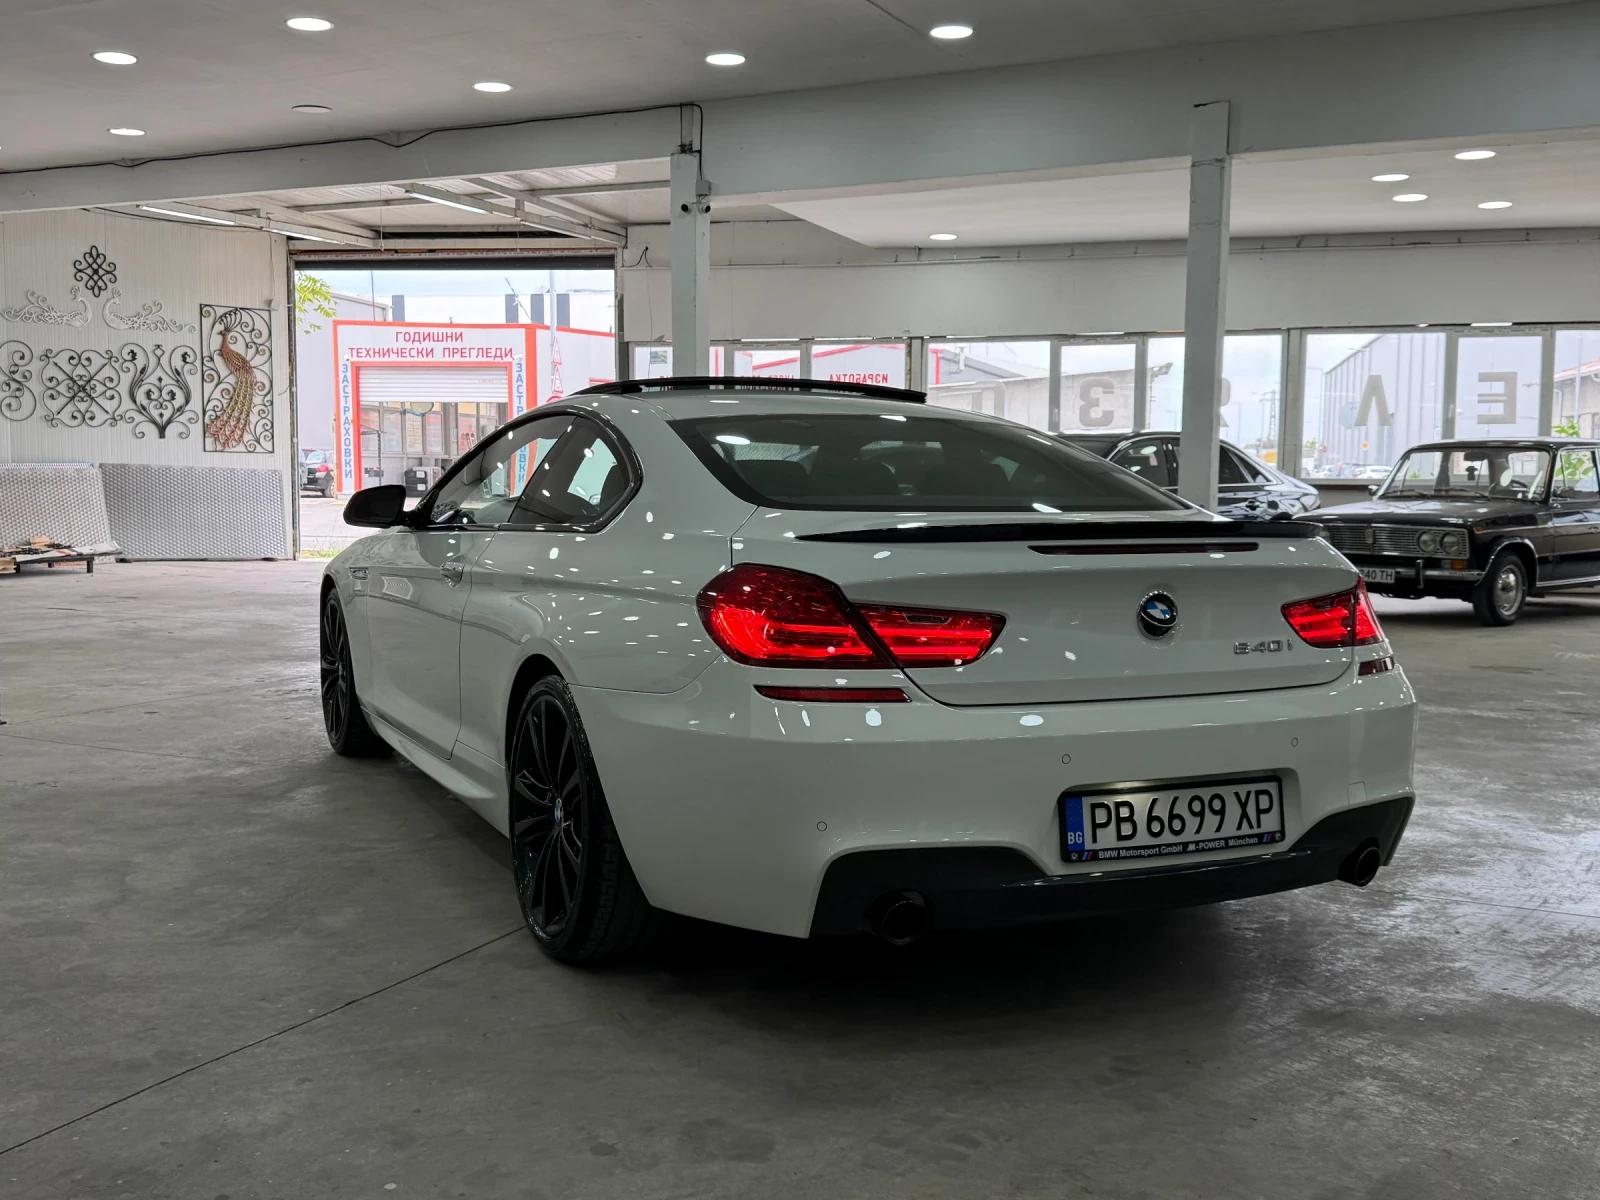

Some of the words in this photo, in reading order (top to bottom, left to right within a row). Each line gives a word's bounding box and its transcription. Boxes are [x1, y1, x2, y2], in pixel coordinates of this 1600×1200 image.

[395, 331, 464, 344] ГОДИШНИ
[348, 347, 434, 359] ТЕХНИЧЕСКИ
[442, 347, 514, 360] ПРЕГЛЕДИ
[341, 363, 353, 479] ЗАСТРАХОВКИ
[1380, 570, 1393, 581] TH
[1090, 800, 1138, 844] PB
[1146, 793, 1226, 838] 6699
[1233, 789, 1274, 831] XP
[1067, 832, 1083, 845] BG
[1098, 850, 1118, 859] BMW
[1119, 845, 1159, 858] Motorsport
[1160, 843, 1183, 854] GmbH
[1187, 839, 1226, 852] M-POWER
[1228, 836, 1258, 847] München
